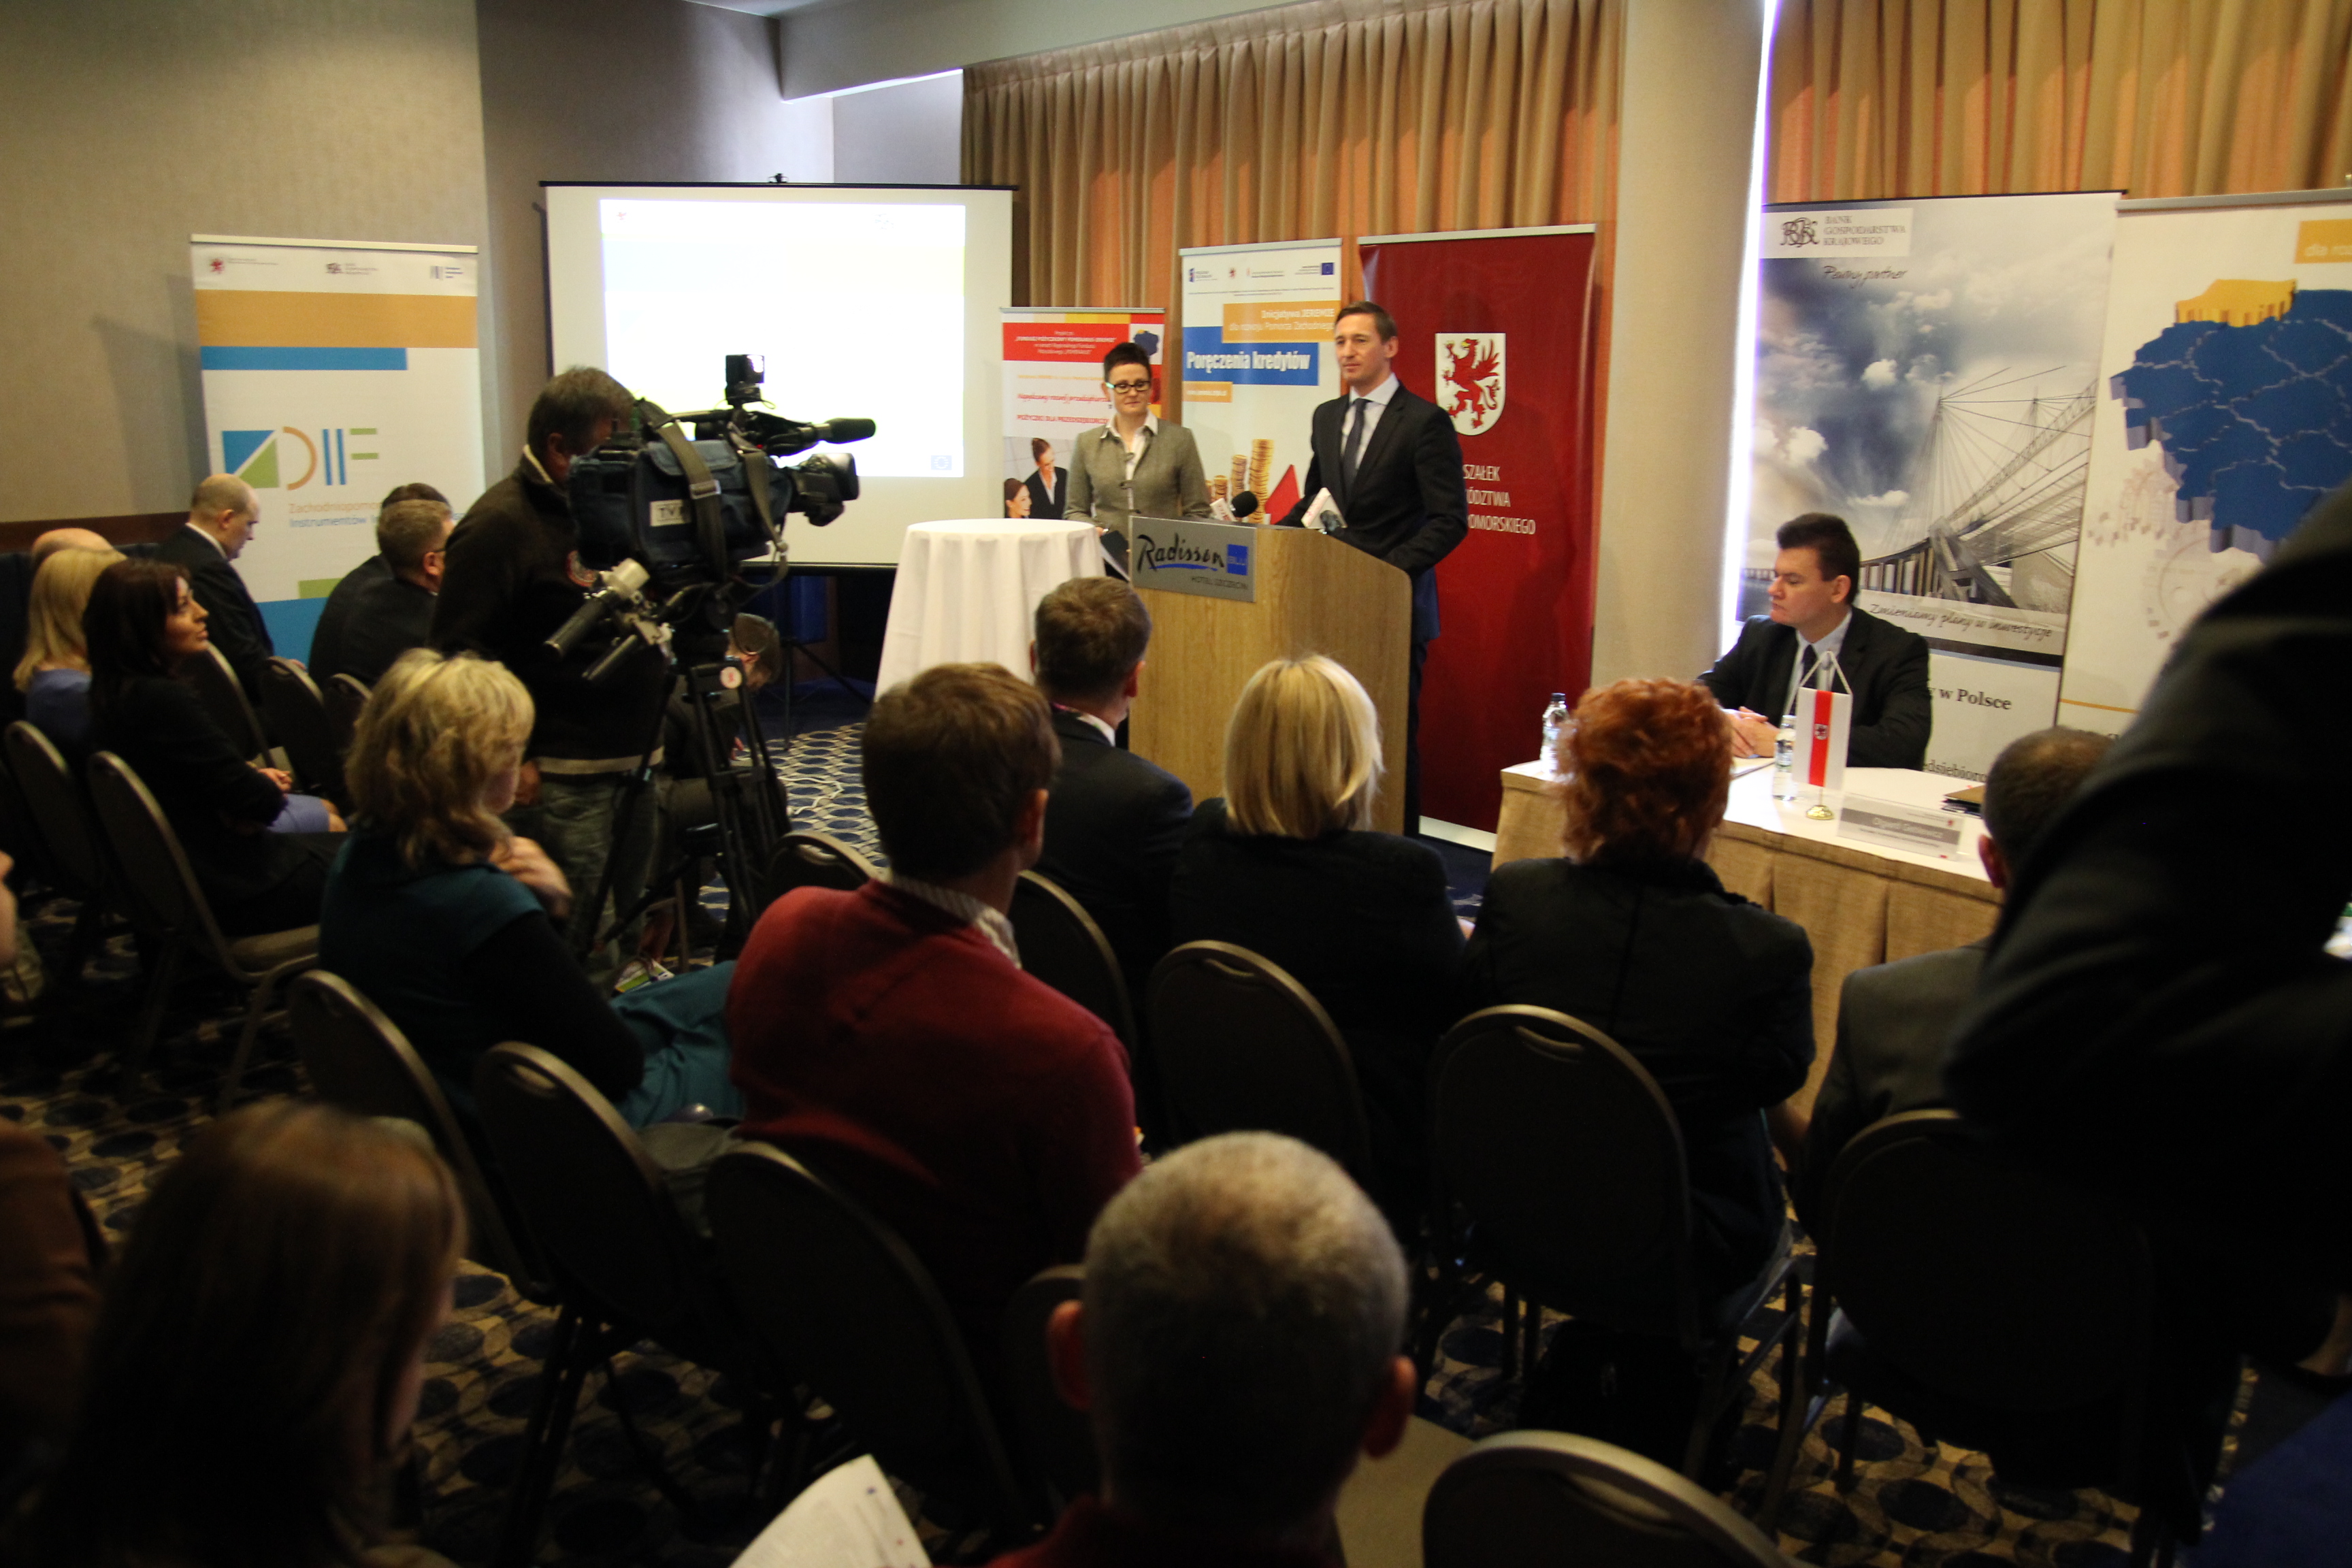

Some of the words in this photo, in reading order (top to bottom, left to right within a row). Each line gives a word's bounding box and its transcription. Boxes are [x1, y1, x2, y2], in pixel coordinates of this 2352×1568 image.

[1187, 351, 1251, 374] Poręczenia
[1252, 350, 1311, 372] kredytów
[1462, 464, 1501, 481] SZAŁEK
[1466, 486, 1511, 507] ÓDZTWA
[1468, 514, 1536, 535] OMORSKIEGO
[1137, 532, 1224, 574] Radisson
[1938, 689, 1953, 700] w
[1956, 688, 2012, 710] Polsce
